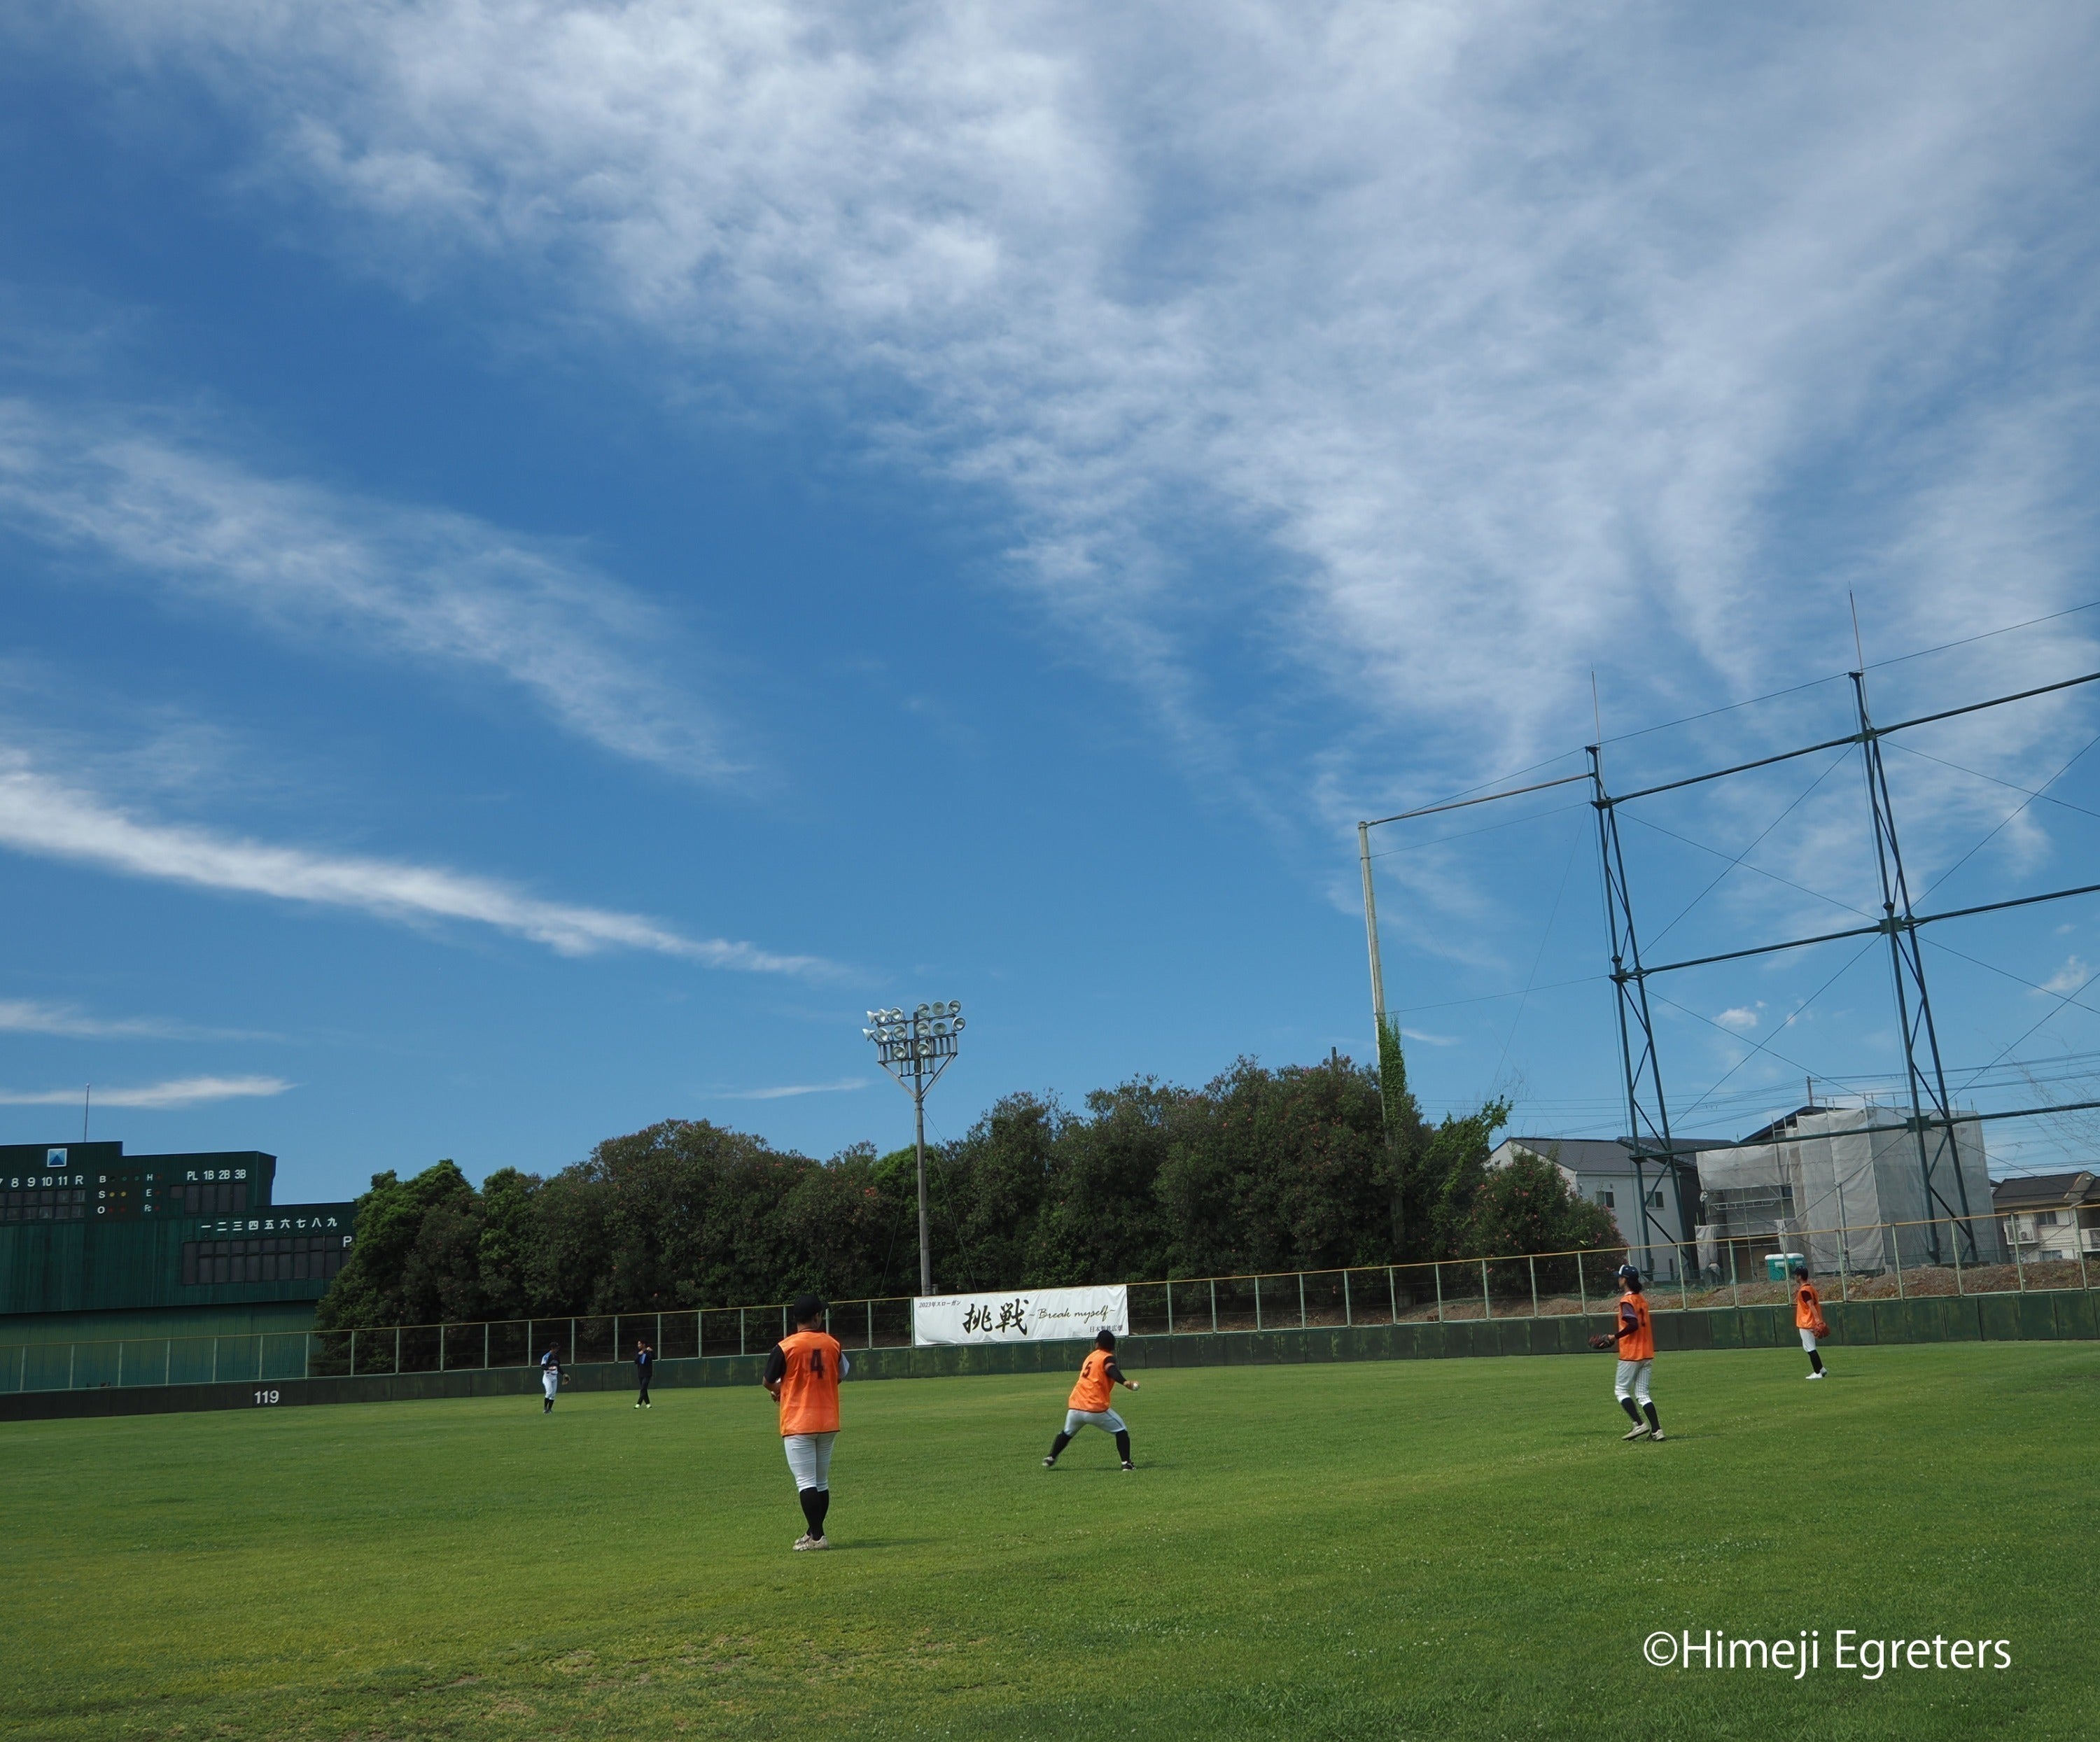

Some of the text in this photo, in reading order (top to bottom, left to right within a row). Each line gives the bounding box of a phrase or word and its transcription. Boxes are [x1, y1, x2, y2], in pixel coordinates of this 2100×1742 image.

[11, 1178, 19, 1188] 8
[27, 1177, 36, 1187] 9
[41, 1176, 53, 1186] 10
[58, 1176, 68, 1186] 11
[75, 1175, 83, 1185] R
[187, 1169, 246, 1181] PL 1B 2B 3B
[343, 1236, 352, 1248] P
[918, 1300, 962, 1308] 2023年スローガン
[962, 1298, 1029, 1335] 挑戦
[810, 1349, 824, 1379] 4
[1082, 1361, 1093, 1379] 5
[254, 1390, 279, 1404] 119
